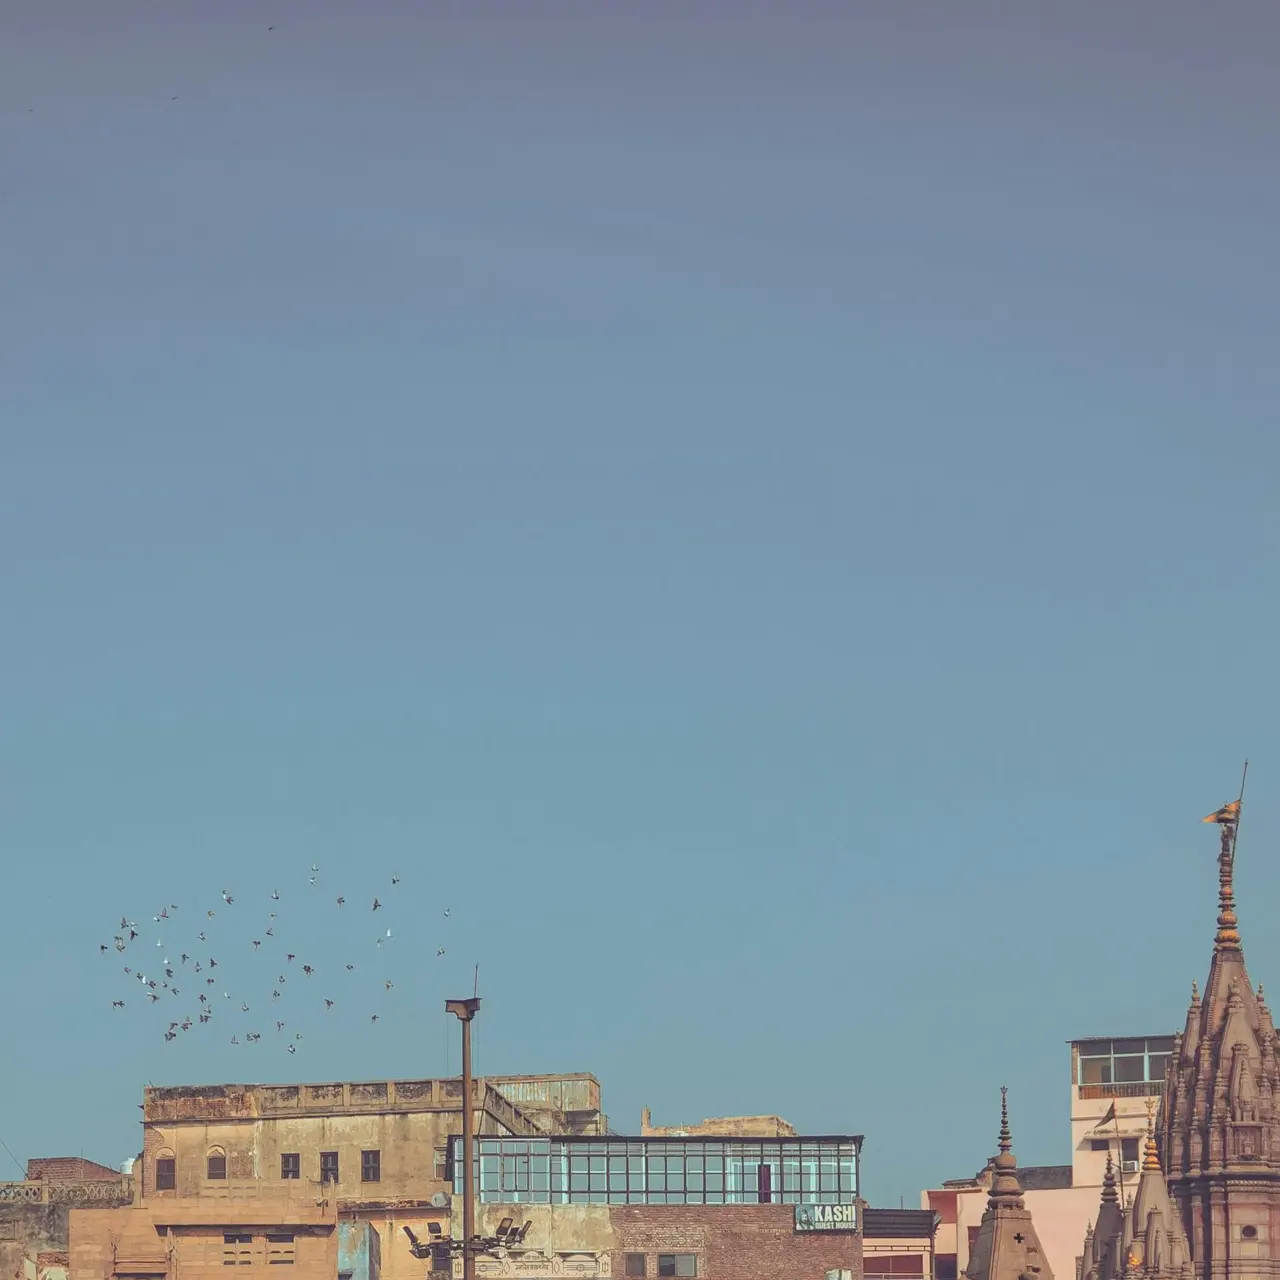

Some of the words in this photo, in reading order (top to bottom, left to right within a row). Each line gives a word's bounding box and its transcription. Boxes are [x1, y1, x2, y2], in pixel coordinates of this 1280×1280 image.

[814, 1205, 856, 1222] KASHI
[815, 1221, 835, 1229] GUEST
[836, 1221, 856, 1229] HOUSE
